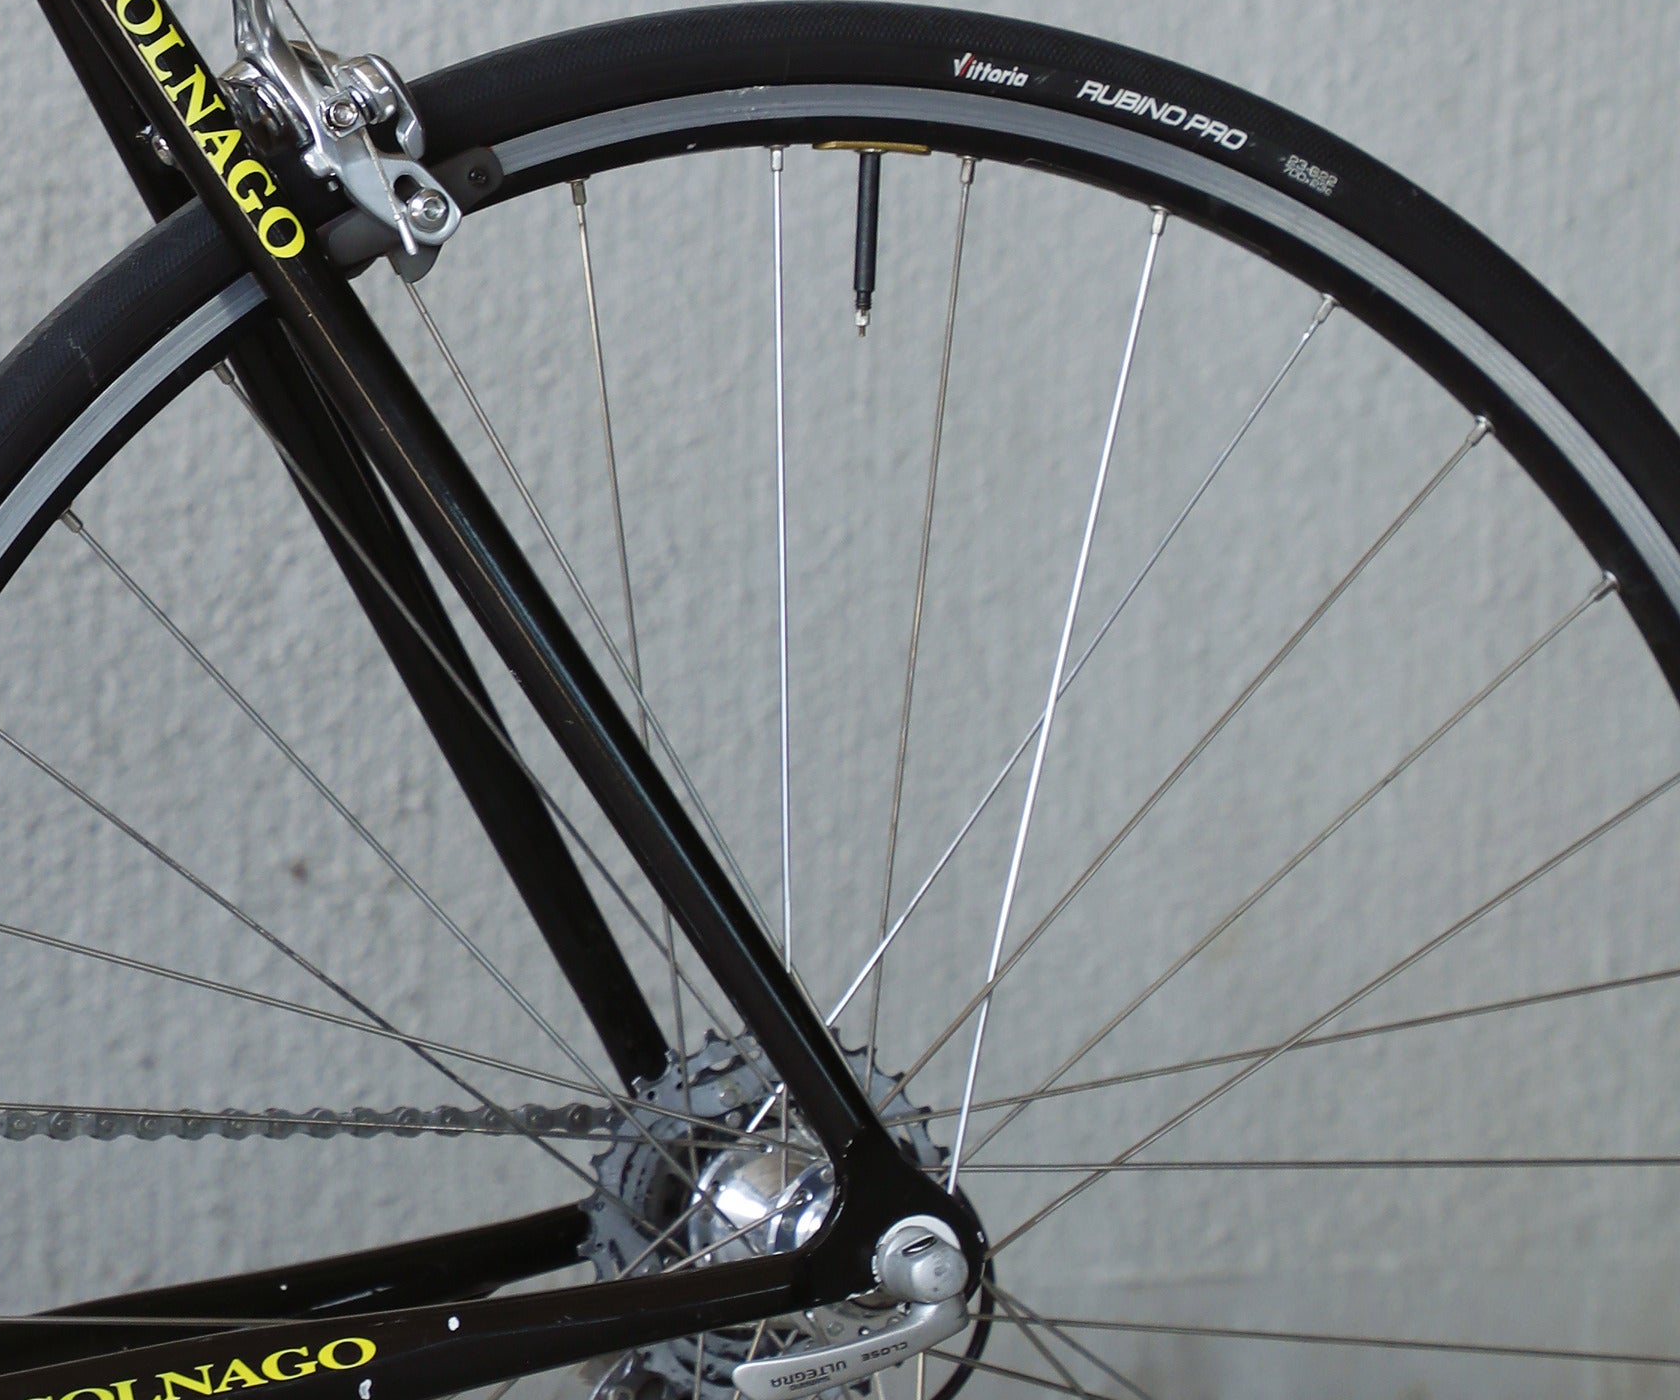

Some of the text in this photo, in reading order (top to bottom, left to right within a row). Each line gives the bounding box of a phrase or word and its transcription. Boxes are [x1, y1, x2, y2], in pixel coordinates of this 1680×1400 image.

[953, 52, 1029, 87] Vittoria
[1076, 80, 1248, 150] RUBINO PRO
[861, 1341, 908, 1362] CLOSE
[771, 1360, 847, 1388] ULTEGRA
